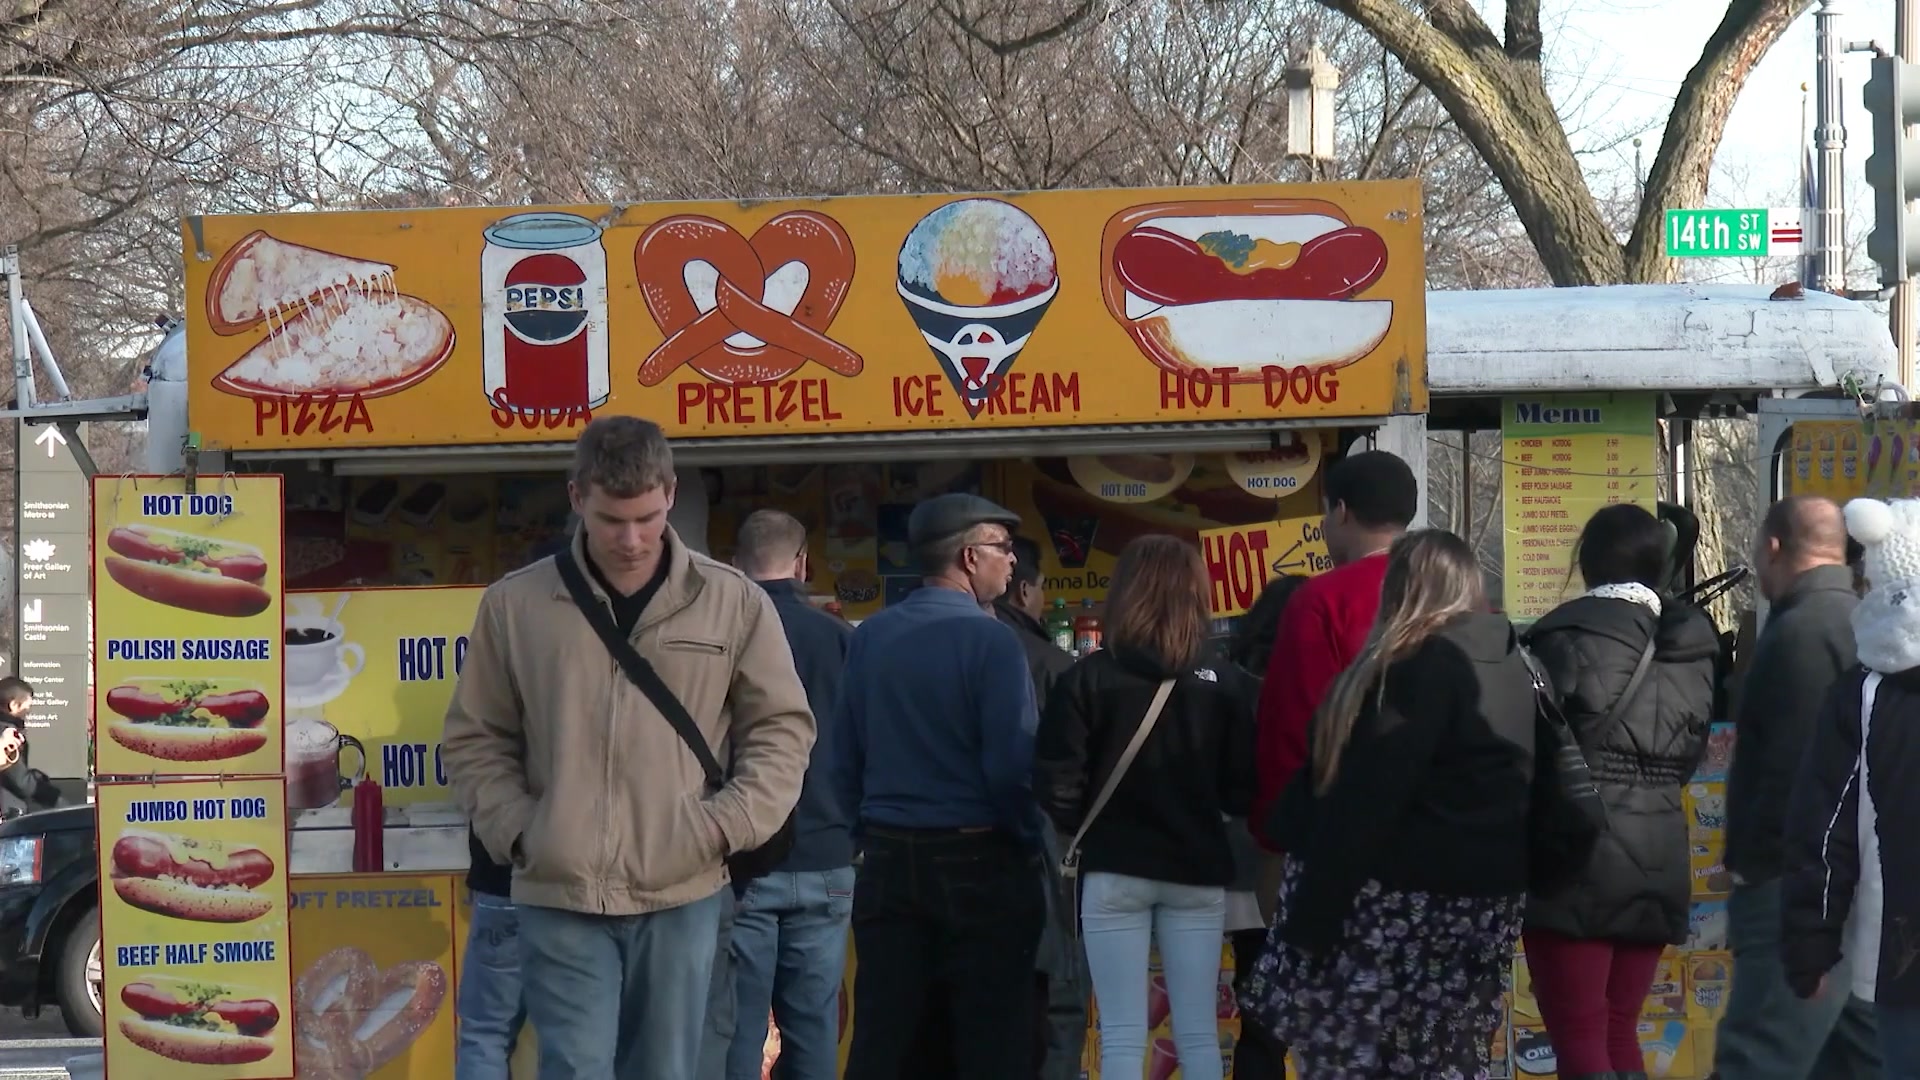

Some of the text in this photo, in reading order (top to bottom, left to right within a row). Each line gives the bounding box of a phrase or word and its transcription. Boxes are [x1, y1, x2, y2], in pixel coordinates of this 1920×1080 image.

[1672, 214, 1760, 249] 14th ST
[1738, 234, 1761, 250] SW
[506, 286, 583, 310] PEPSI
[893, 372, 1080, 417] ICE CREAM
[1160, 365, 1340, 409] HOT DOG
[491, 387, 592, 429] SODA
[677, 378, 842, 425] PRETZEL
[253, 394, 374, 436] PIZZA
[1515, 403, 1602, 424] Menu
[1521, 453, 1532, 461] BEEF
[1101, 484, 1146, 498] HOT DOG
[1248, 477, 1297, 488] HOT DOG
[1522, 482, 1532, 490] BEEF
[24, 502, 69, 510] Smithsonian
[143, 494, 232, 516] HOT DOG
[24, 563, 71, 572] Freer Gallery
[1204, 530, 1269, 612] HOT
[1306, 552, 1332, 572] Tea
[24, 624, 70, 632] Smithsonian
[24, 633, 47, 641] Castle
[107, 640, 270, 660] POLISH SAUSAGE
[399, 637, 447, 681] HOT
[44, 676, 65, 684] Center
[382, 743, 427, 788] HOT
[127, 798, 266, 823] JUMBO HOT DOG
[290, 889, 441, 909] FT PRETZEL
[117, 941, 275, 967] BEEF HALF SMOKE
